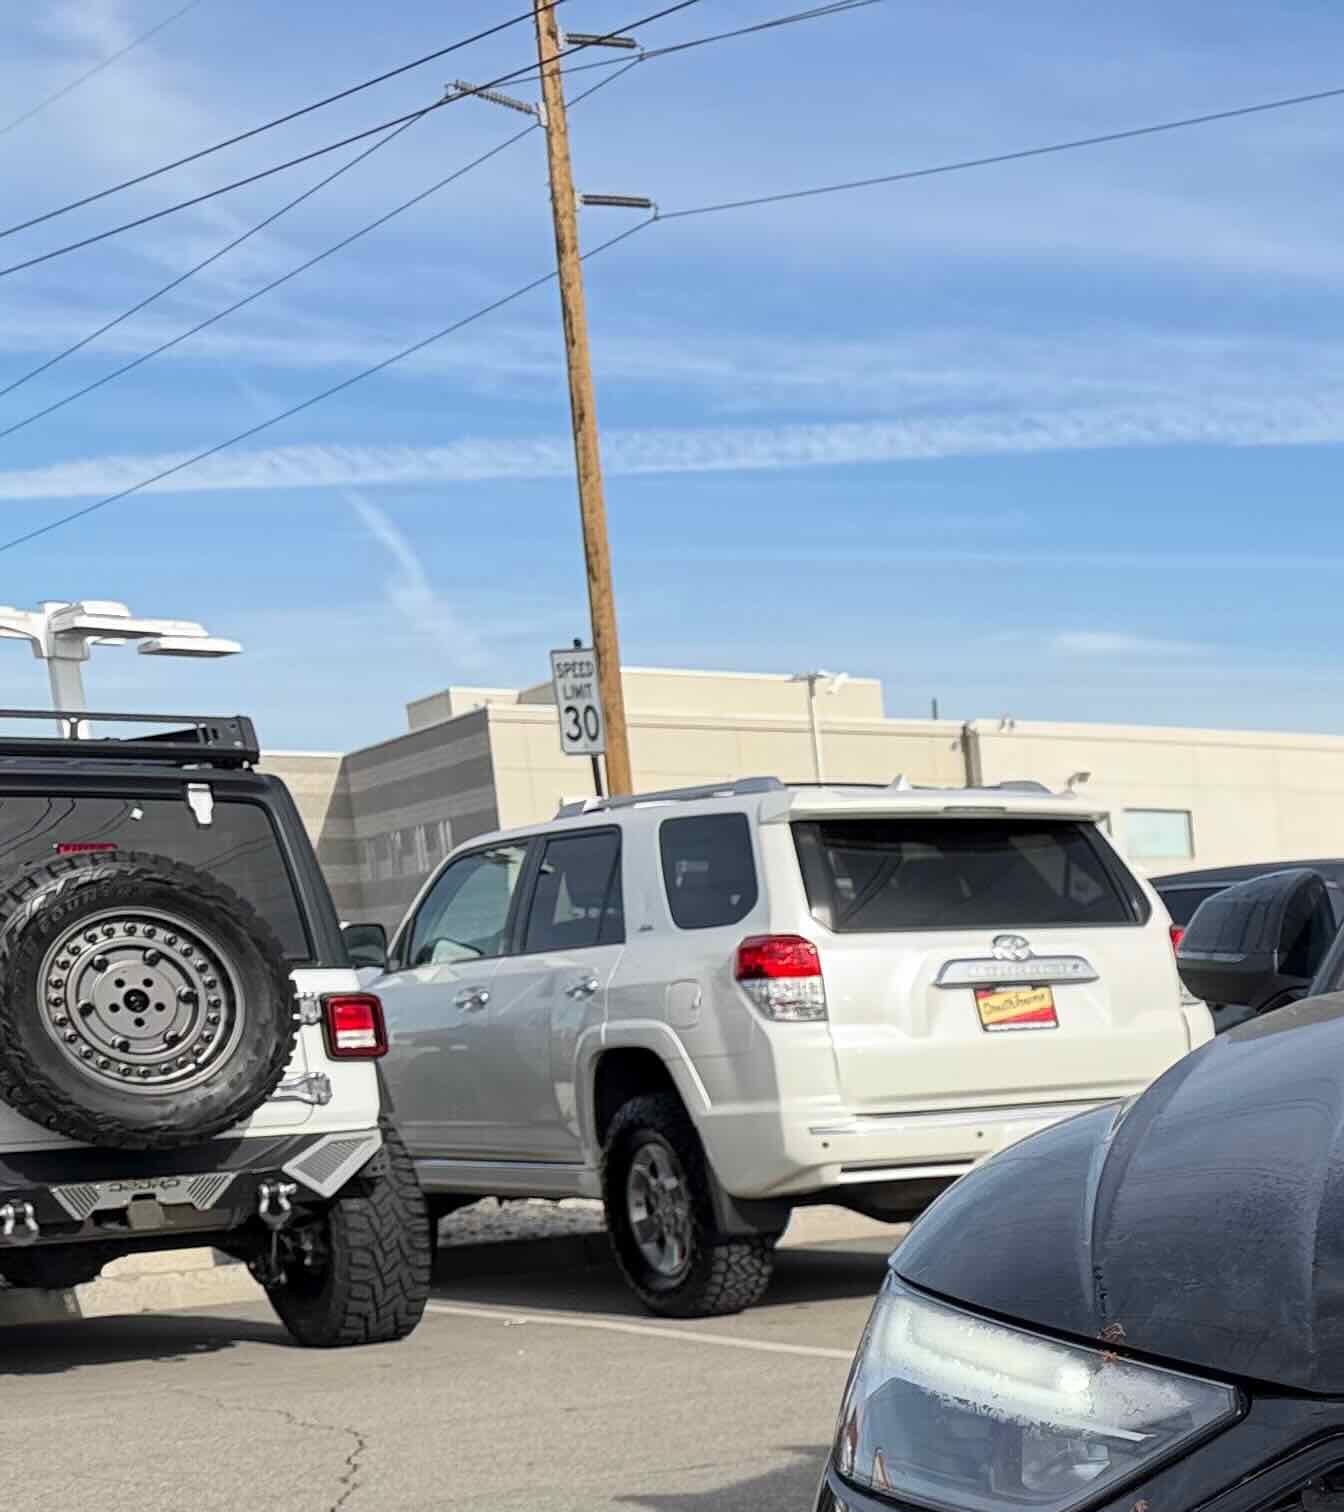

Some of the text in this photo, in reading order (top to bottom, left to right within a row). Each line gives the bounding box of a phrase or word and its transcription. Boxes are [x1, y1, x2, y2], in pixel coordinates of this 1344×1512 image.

[556, 660, 593, 678] SPEED
[562, 683, 592, 700] LIMIT
[564, 705, 599, 742] 30
